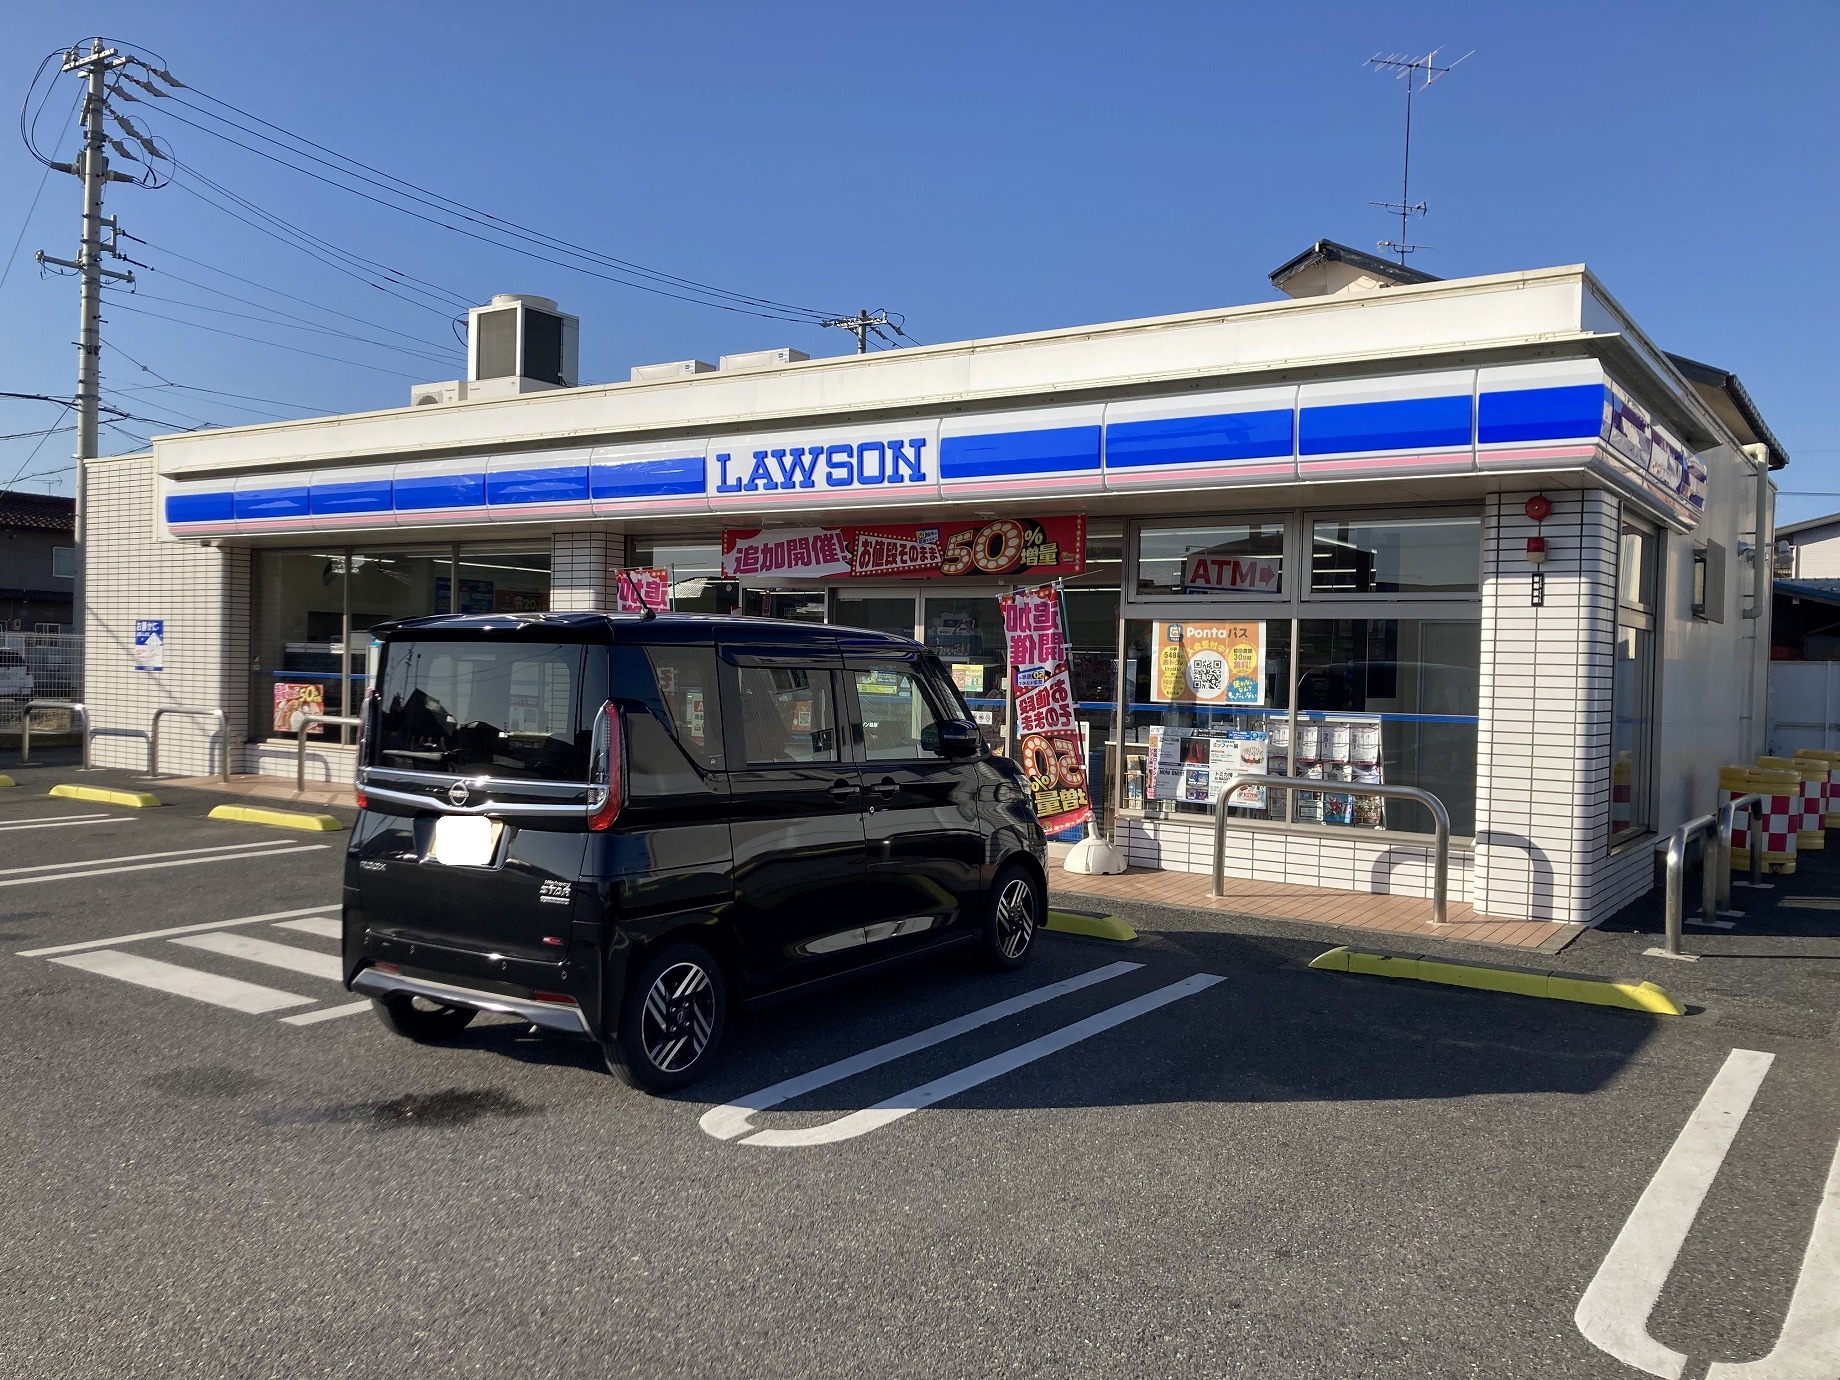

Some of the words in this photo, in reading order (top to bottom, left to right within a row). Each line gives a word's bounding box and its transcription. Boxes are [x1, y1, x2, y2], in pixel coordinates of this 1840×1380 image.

[716, 438, 926, 493] LAWSON
[733, 532, 849, 575] 追加開催!
[859, 538, 938, 569] お値段そのまま
[1020, 543, 1058, 566] 増量
[1190, 559, 1257, 587] ATM
